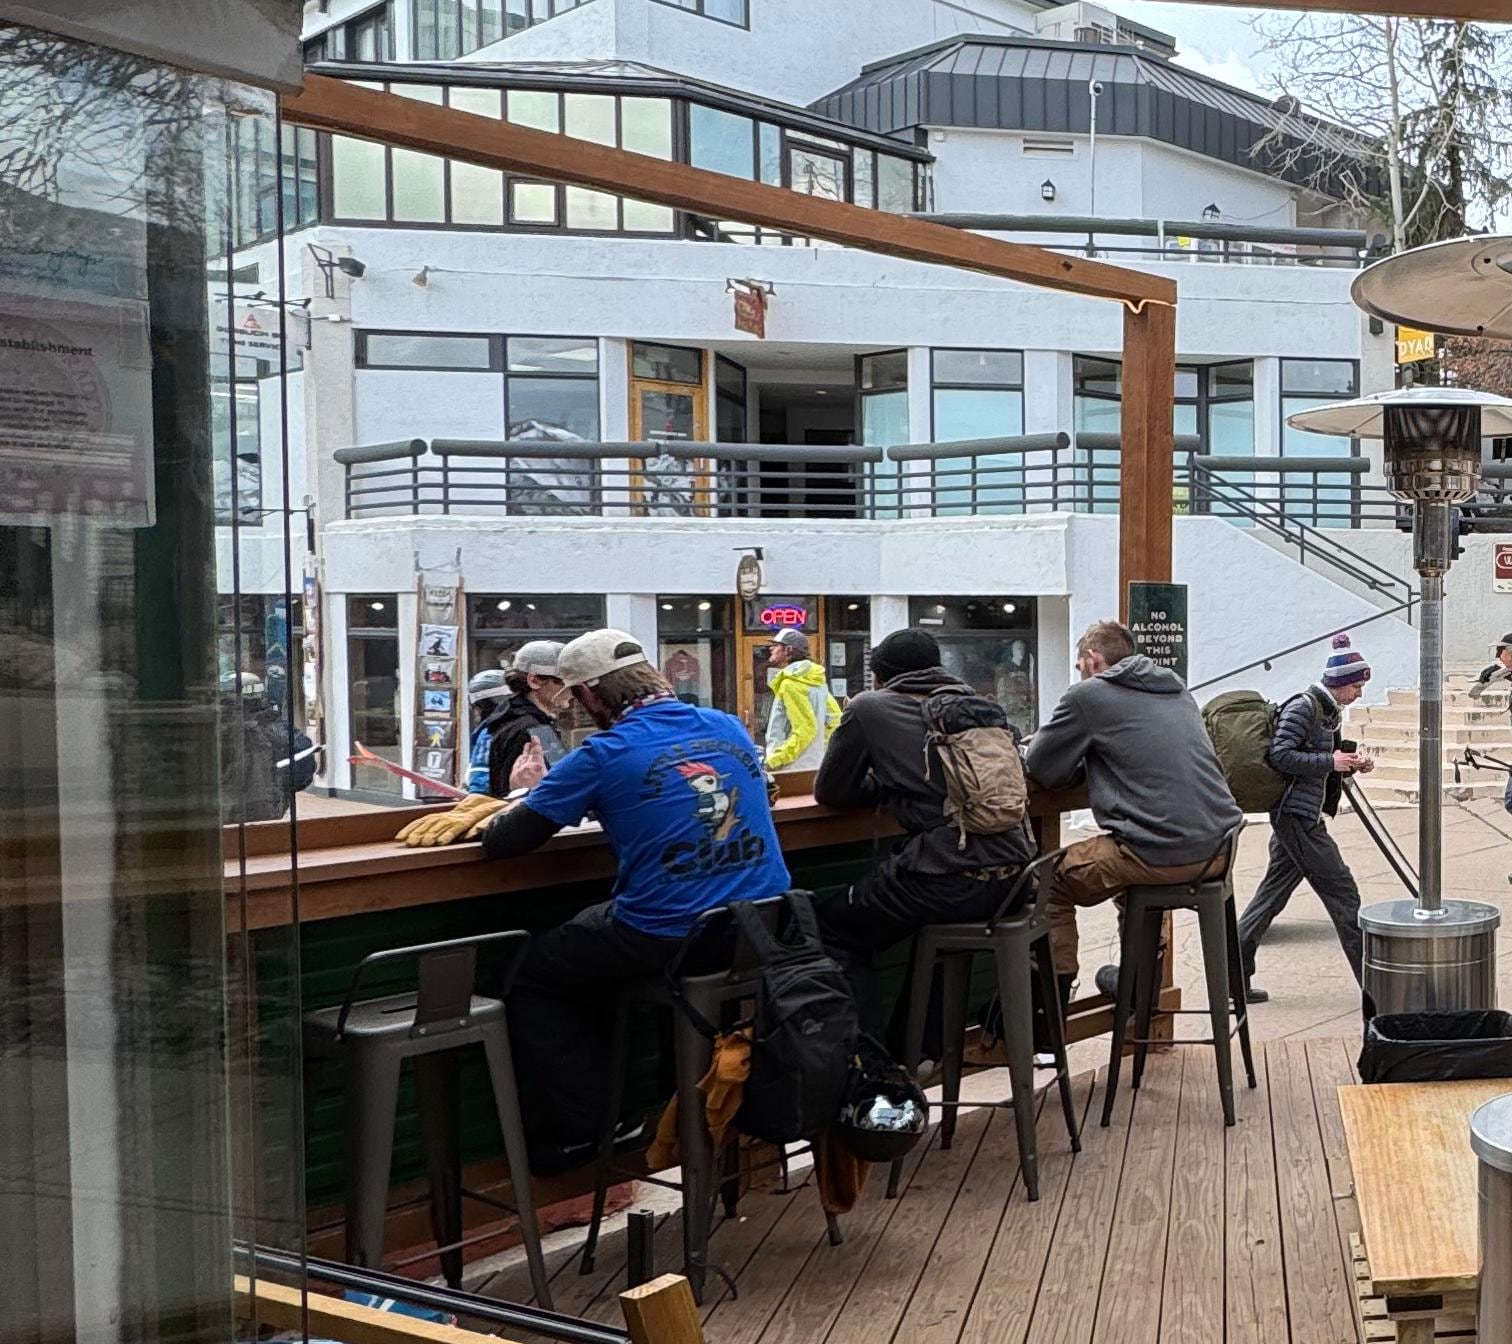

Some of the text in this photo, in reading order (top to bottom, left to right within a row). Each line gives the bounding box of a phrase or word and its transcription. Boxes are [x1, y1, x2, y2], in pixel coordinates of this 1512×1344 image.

[760, 608, 808, 625] OPEN
[1150, 610, 1168, 621] NO
[1131, 622, 1184, 632] ALCOHOL
[1137, 634, 1183, 644] BEYOND
[1145, 646, 1171, 655] THIS
[1151, 657, 1178, 667] OINT
